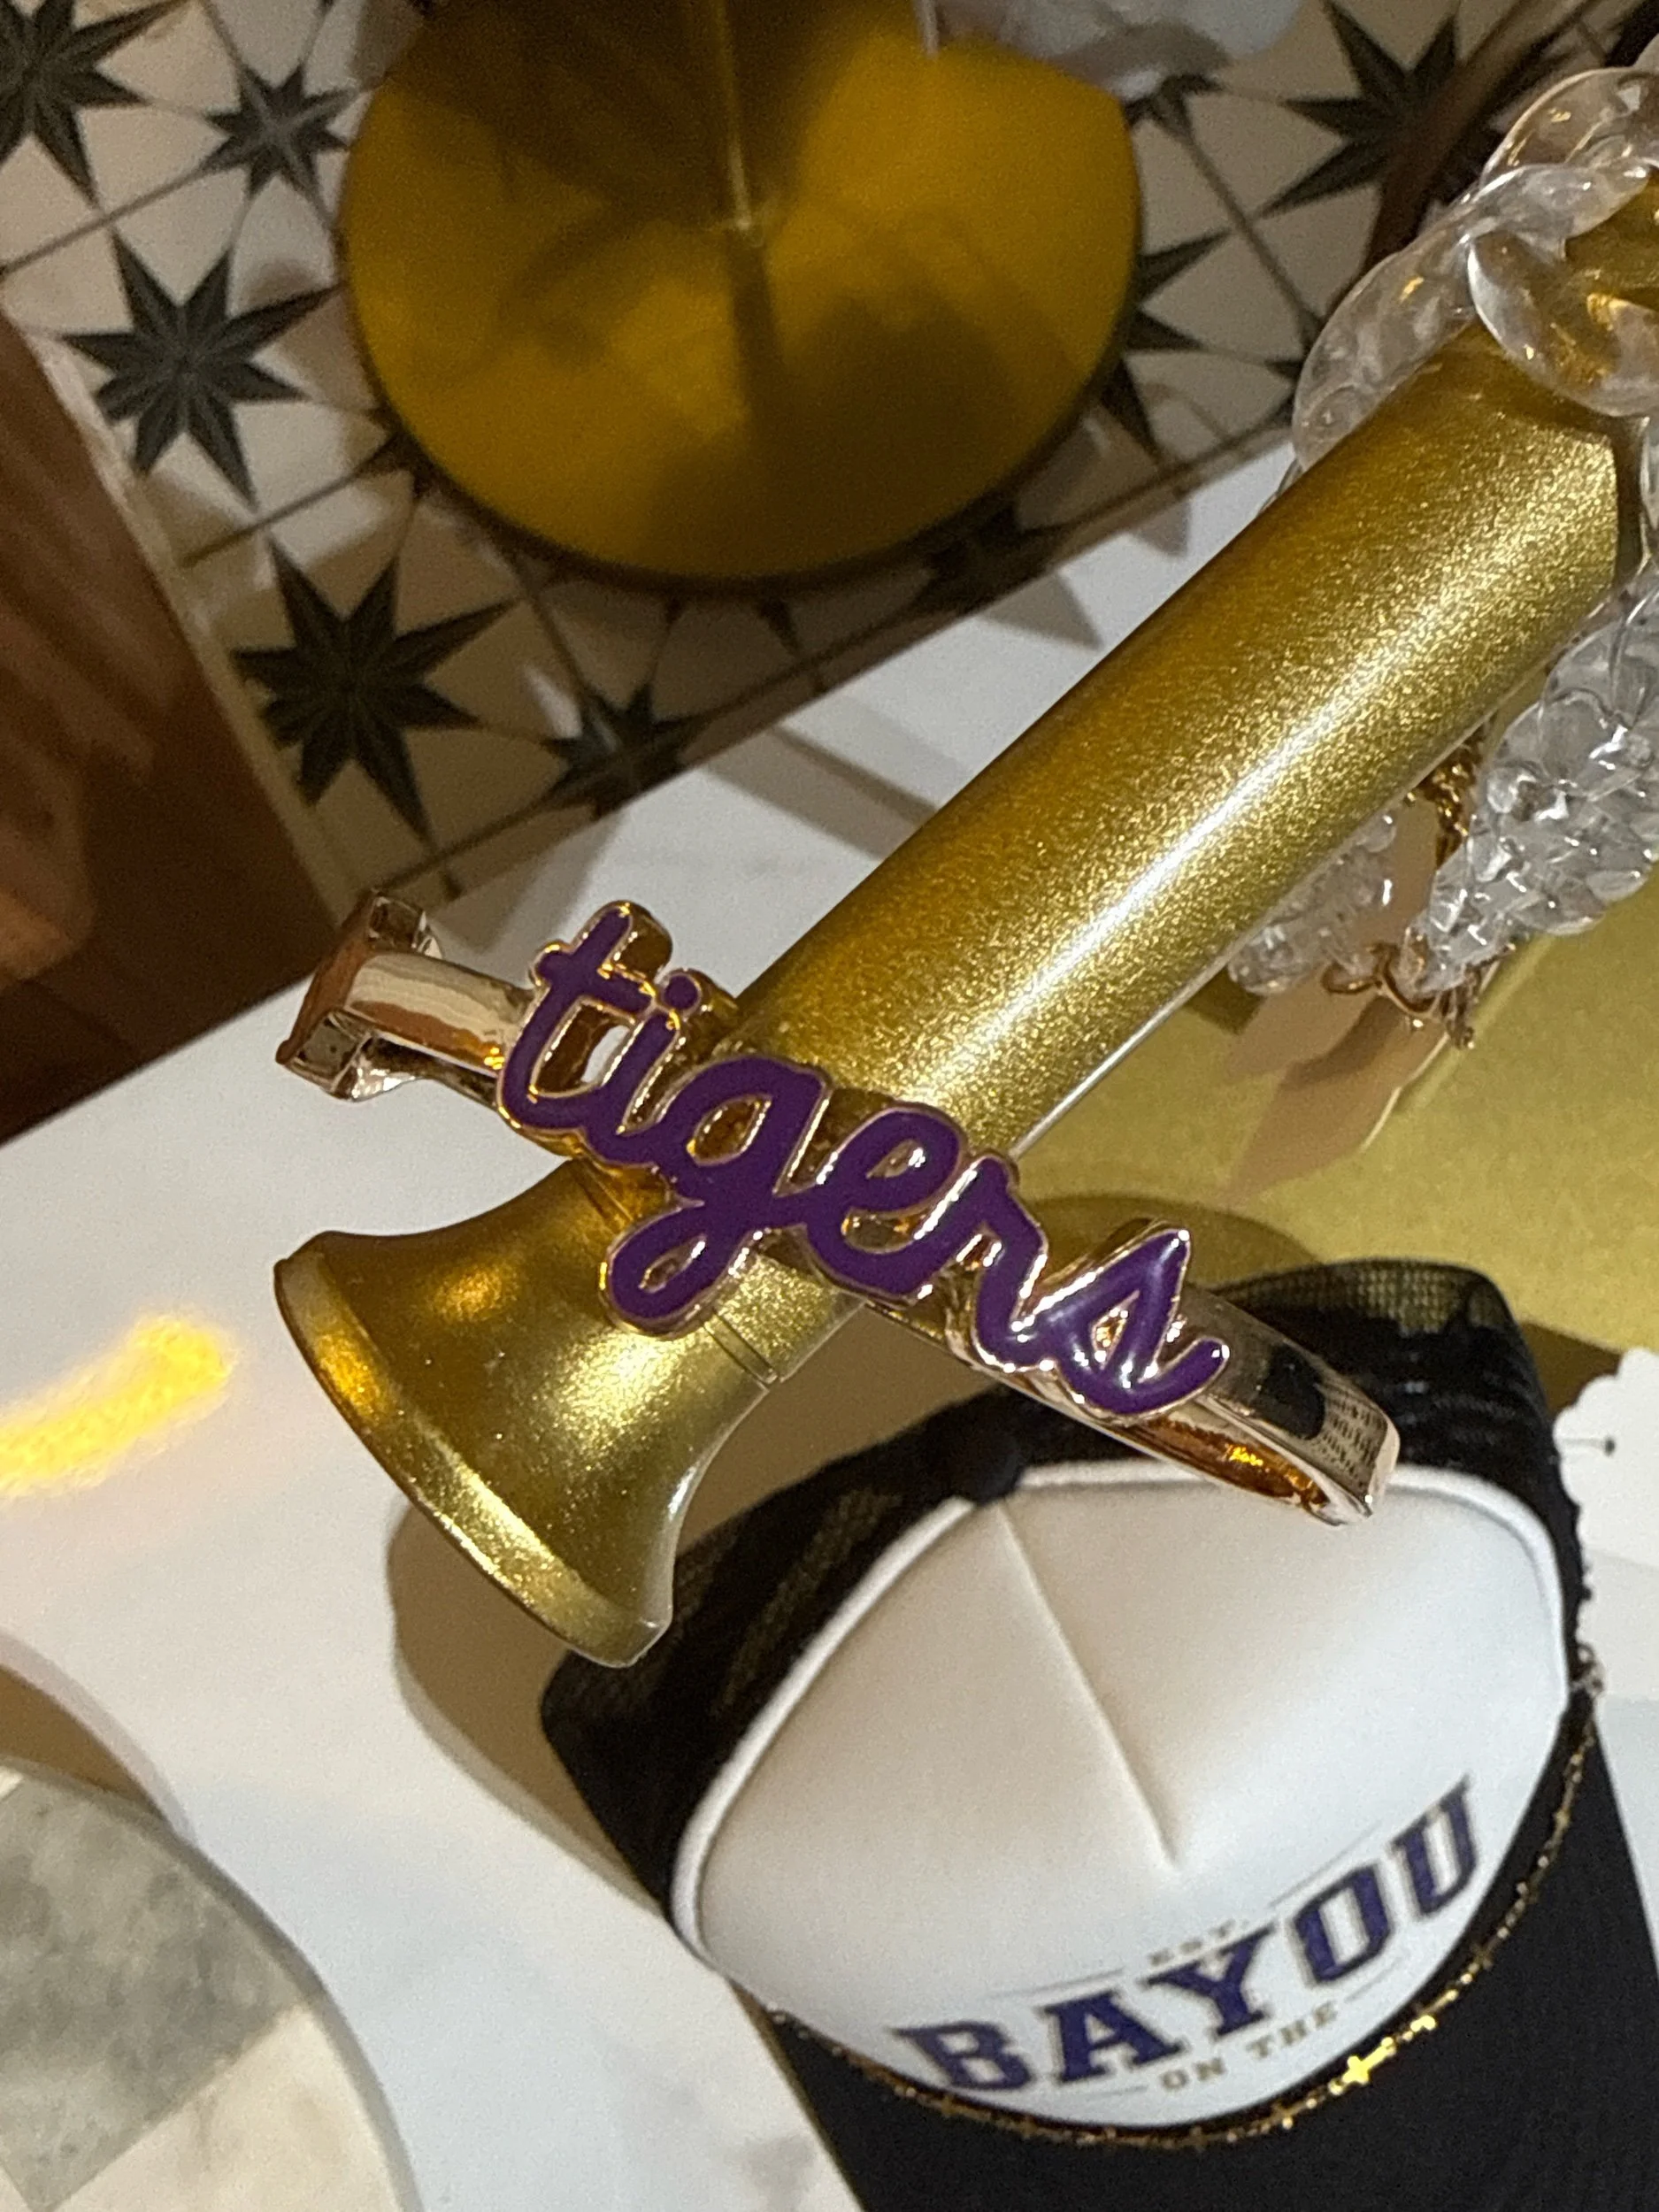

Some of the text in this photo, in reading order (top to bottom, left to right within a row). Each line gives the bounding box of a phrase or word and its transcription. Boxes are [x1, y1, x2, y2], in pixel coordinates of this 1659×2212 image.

[500, 901, 1231, 1417] tigers
[890, 1772, 1479, 2093] BAYOU
[1159, 2001, 1338, 2092] ON THE
